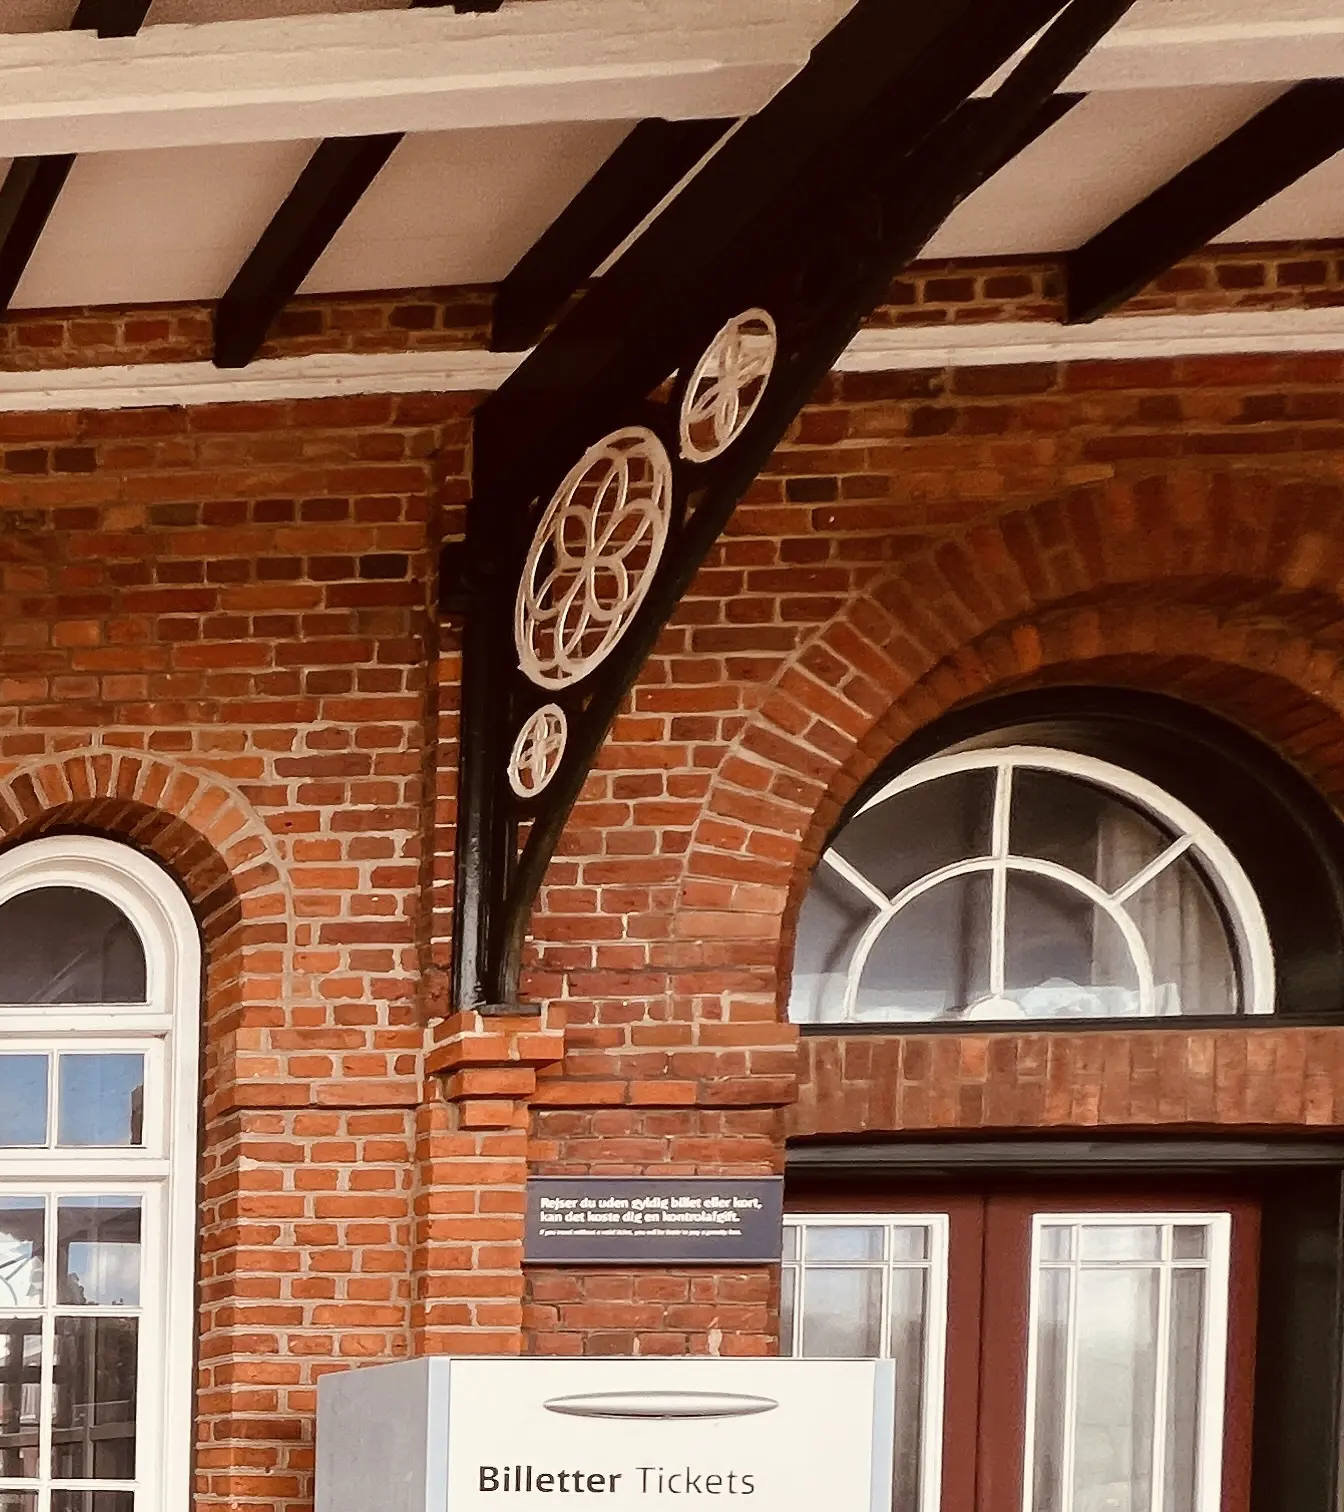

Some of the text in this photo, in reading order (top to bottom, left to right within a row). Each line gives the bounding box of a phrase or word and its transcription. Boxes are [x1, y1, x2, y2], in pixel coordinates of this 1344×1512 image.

[540, 1197, 578, 1211] Rejser
[579, 1197, 596, 1209] du
[598, 1197, 629, 1209] uden
[540, 1210, 563, 1222] kan
[564, 1210, 585, 1222] det
[587, 1210, 620, 1222] koste
[622, 1210, 643, 1224] dig
[644, 1212, 659, 1222] en
[479, 1465, 755, 1494] Billetter Tickets
